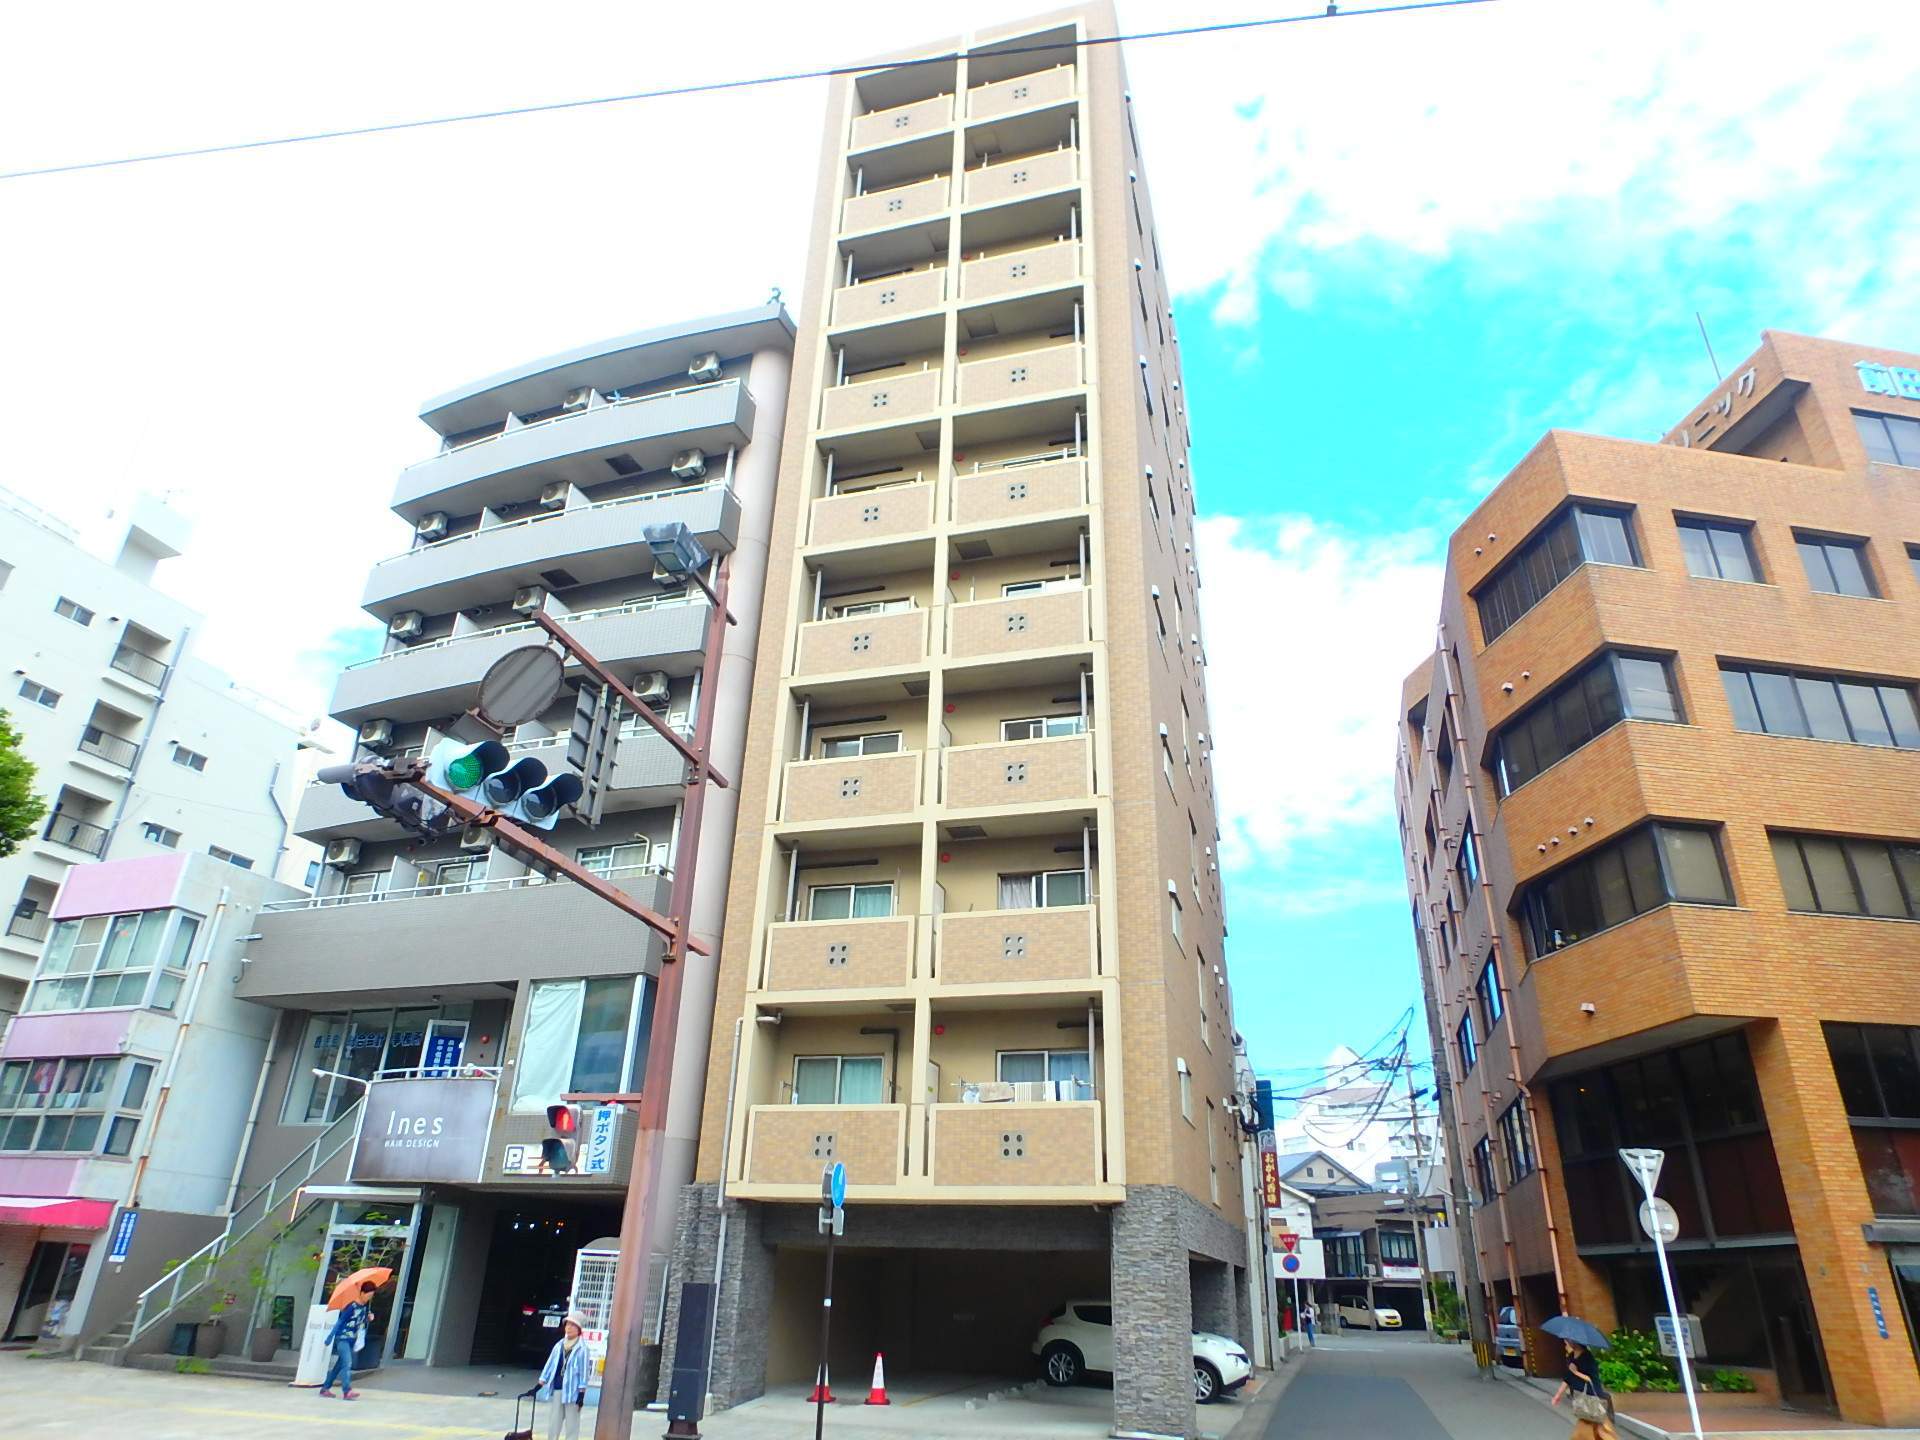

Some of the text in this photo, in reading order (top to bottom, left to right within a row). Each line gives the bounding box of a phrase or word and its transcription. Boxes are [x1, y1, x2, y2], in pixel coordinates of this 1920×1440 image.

[387, 1110, 444, 1135] Ines
[385, 1138, 440, 1149] HAIR DESIGN
[590, 1110, 612, 1170] 押ボタン式
